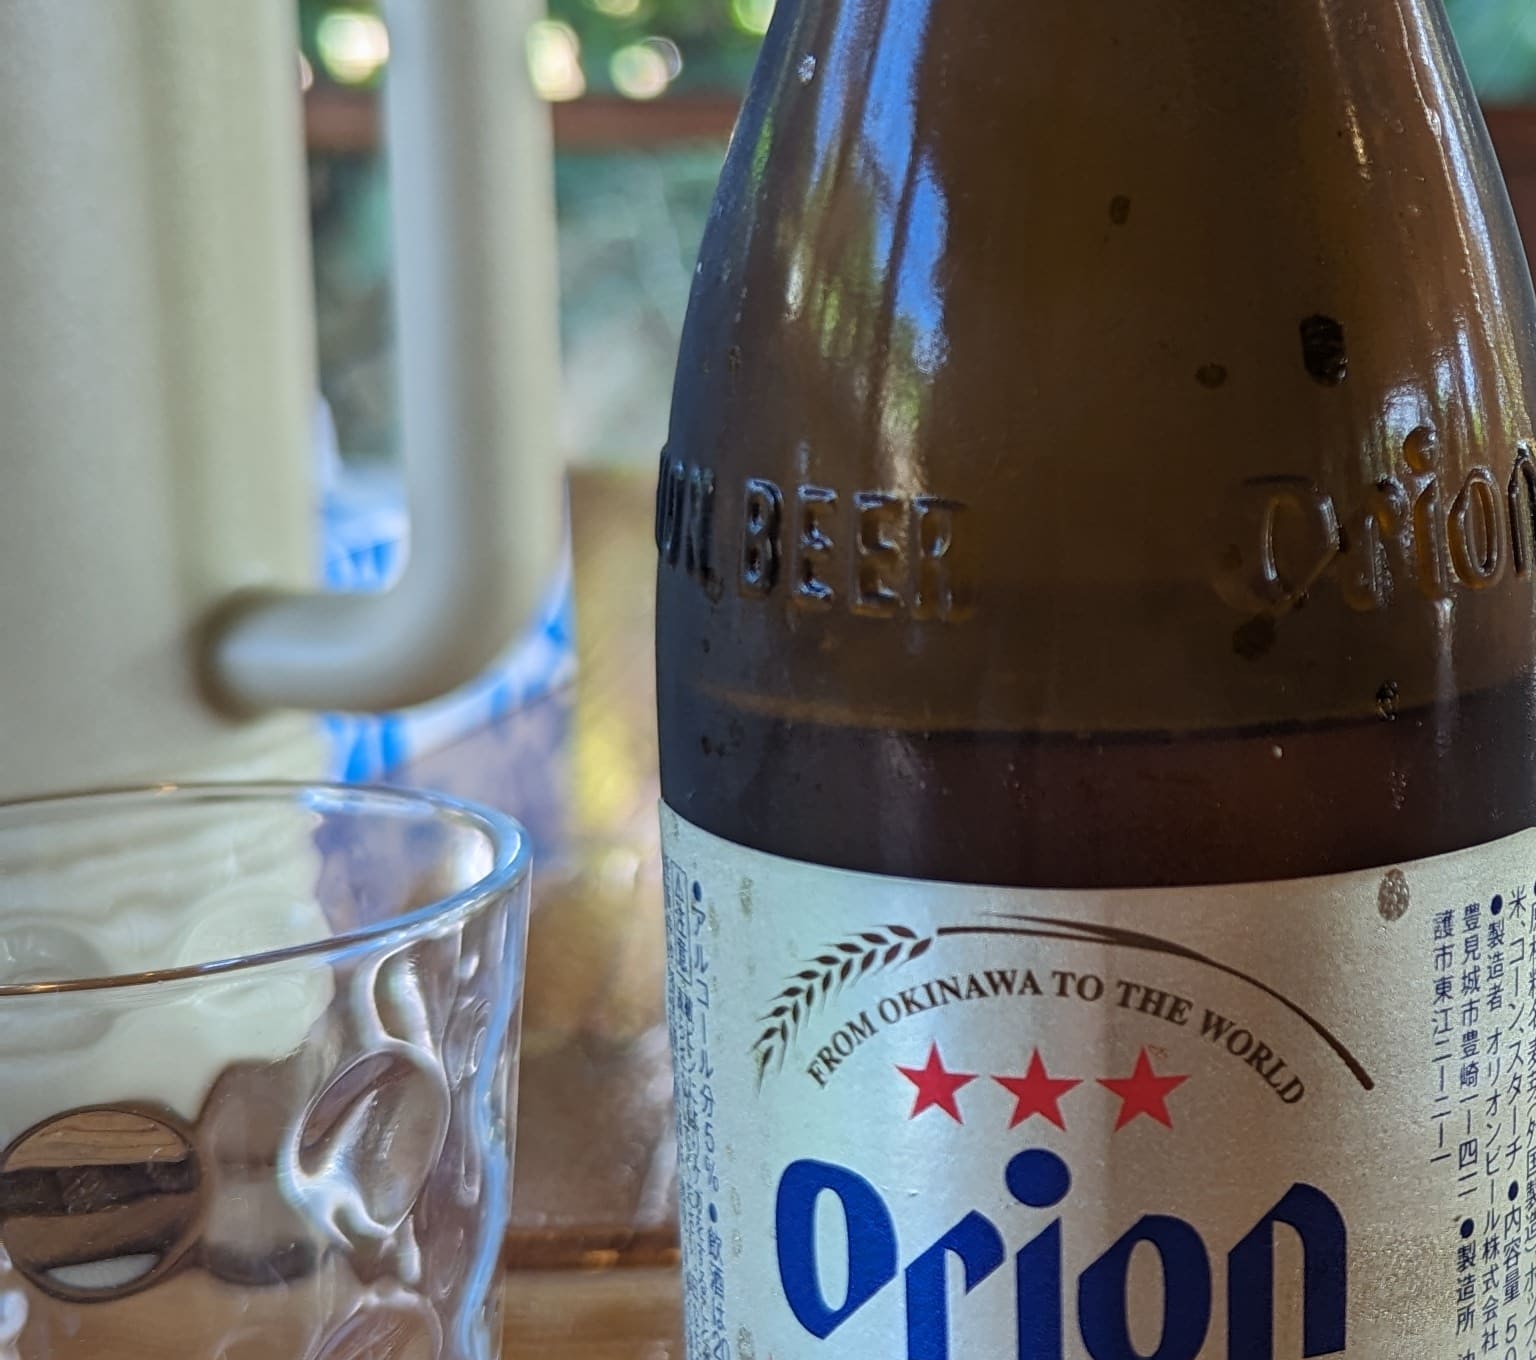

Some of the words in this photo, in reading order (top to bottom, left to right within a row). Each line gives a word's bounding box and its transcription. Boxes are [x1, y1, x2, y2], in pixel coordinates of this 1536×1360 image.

[743, 478, 976, 622] BEER
[1486, 920, 1505, 1012] 製造者
[806, 1012, 877, 1090] FROM
[878, 968, 1043, 1026] OKINAWA
[1051, 969, 1105, 1003] TO
[1116, 980, 1194, 1027] THE
[1199, 1008, 1306, 1107] WORLD
[1481, 1027, 1503, 1356] オリオンビール株式会社
[1455, 1242, 1476, 1336] 製造所
[1502, 1205, 1521, 1307] 内容量
